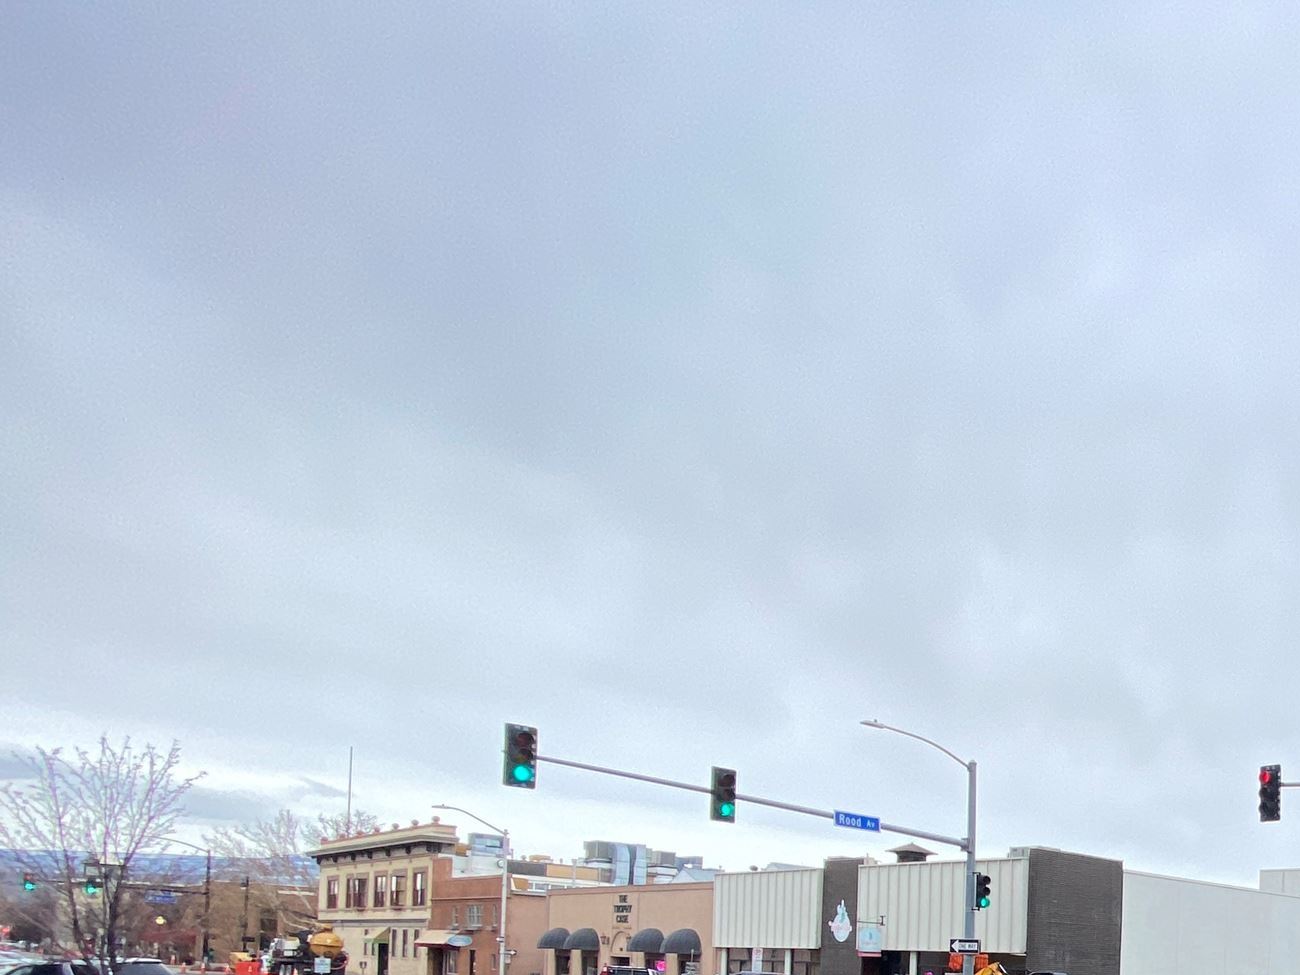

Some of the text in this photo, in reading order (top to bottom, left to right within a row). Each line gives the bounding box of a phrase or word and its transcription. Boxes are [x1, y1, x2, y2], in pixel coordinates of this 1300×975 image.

[839, 813, 876, 829] Rood Av
[618, 894, 629, 904] THE
